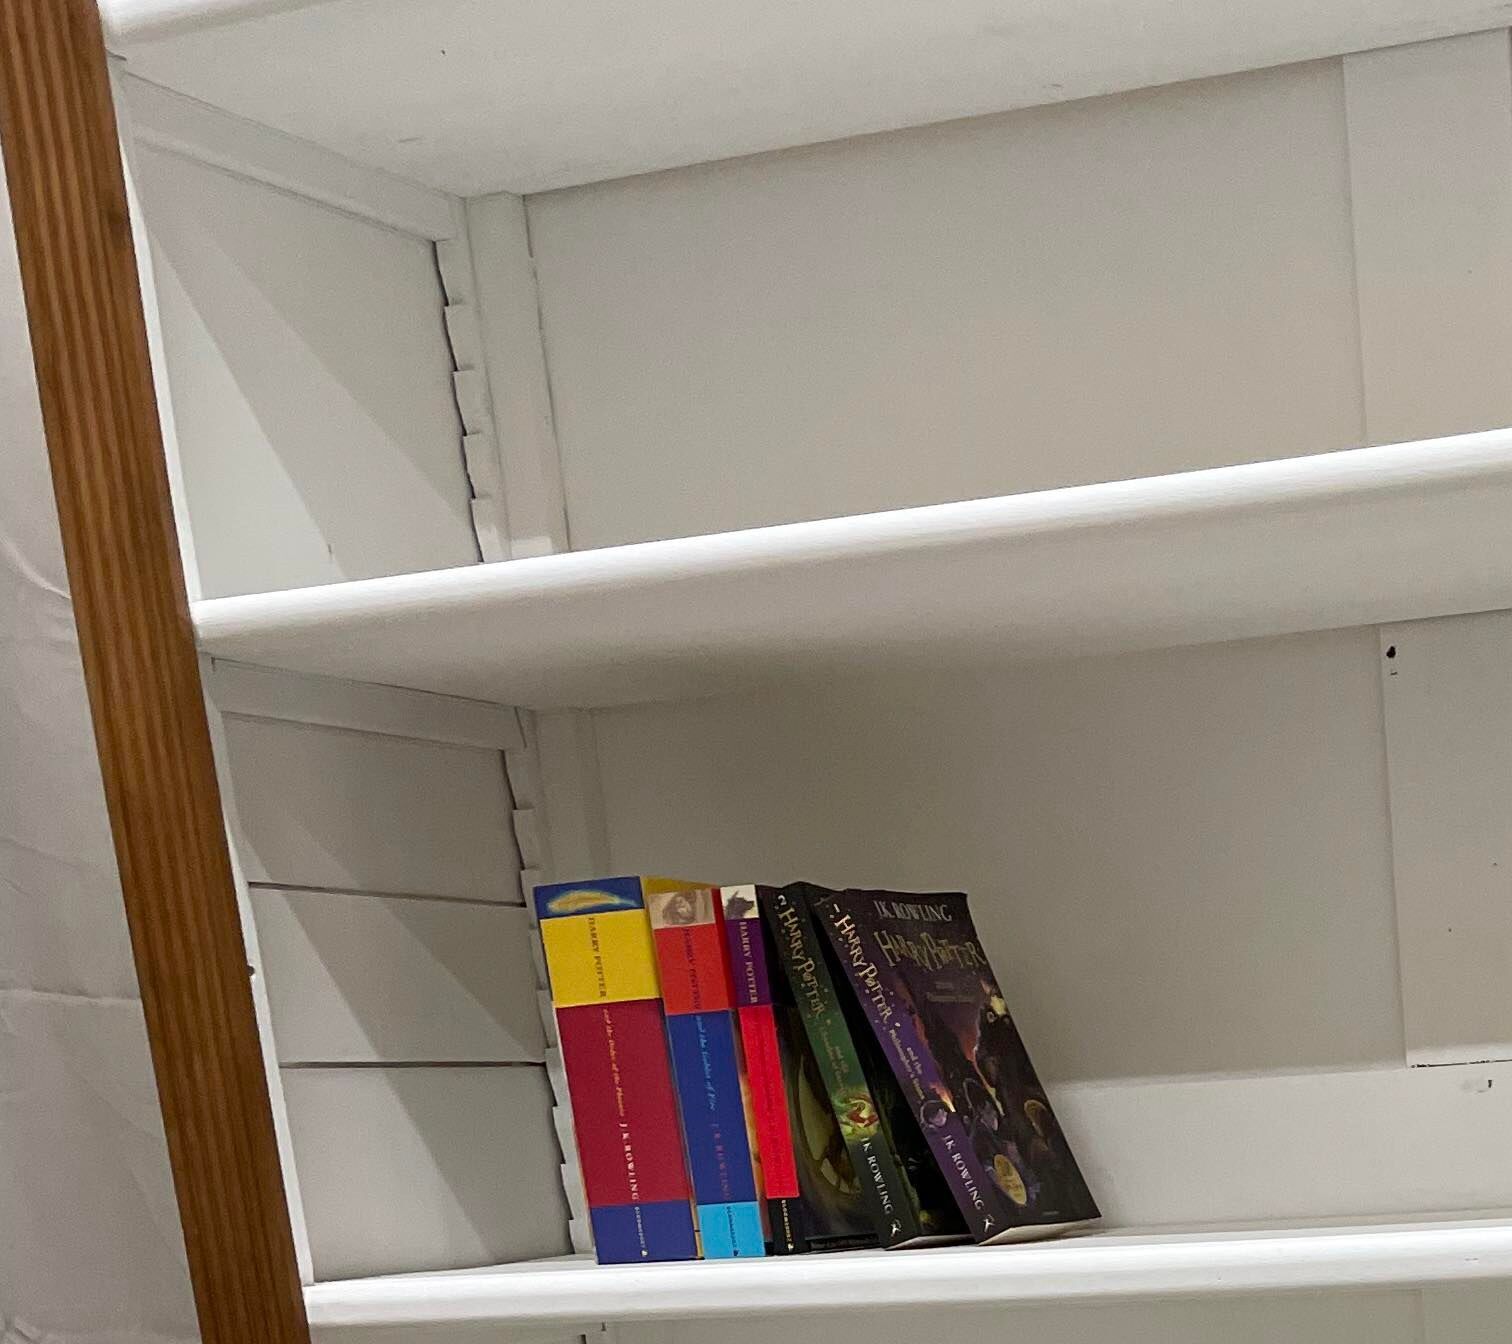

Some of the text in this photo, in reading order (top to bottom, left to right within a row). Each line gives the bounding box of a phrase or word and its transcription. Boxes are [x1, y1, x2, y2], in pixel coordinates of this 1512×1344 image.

[891, 902, 953, 922] ROWLING
[588, 917, 607, 998] HARRY POTTER
[739, 920, 759, 1004] HARRY POTTER
[777, 907, 826, 1019] HARRY POTTER
[834, 913, 893, 1024] HARRY POTTER
[624, 1144, 640, 1200] ROWLING
[866, 1155, 894, 1215] ROWLING
[951, 1152, 985, 1211] ROWLING
